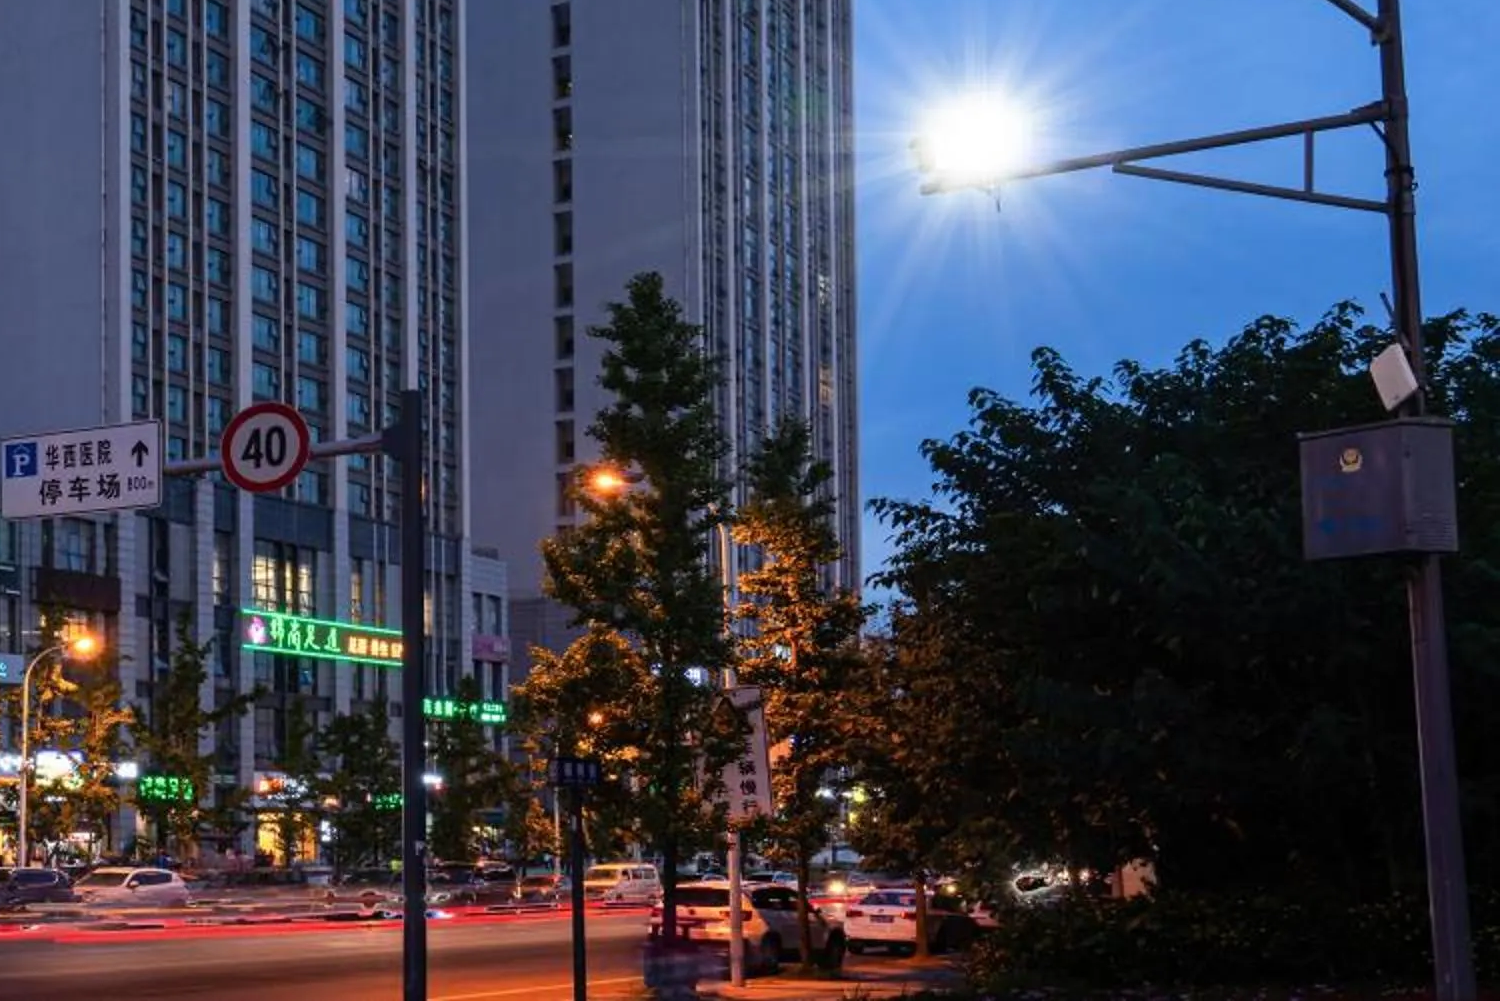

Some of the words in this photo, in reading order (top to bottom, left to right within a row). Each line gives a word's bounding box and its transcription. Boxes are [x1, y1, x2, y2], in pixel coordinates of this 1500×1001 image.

[45, 439, 112, 472] 华西医院
[241, 425, 287, 469] 40
[11, 452, 29, 476] P
[39, 474, 120, 505] 停车场
